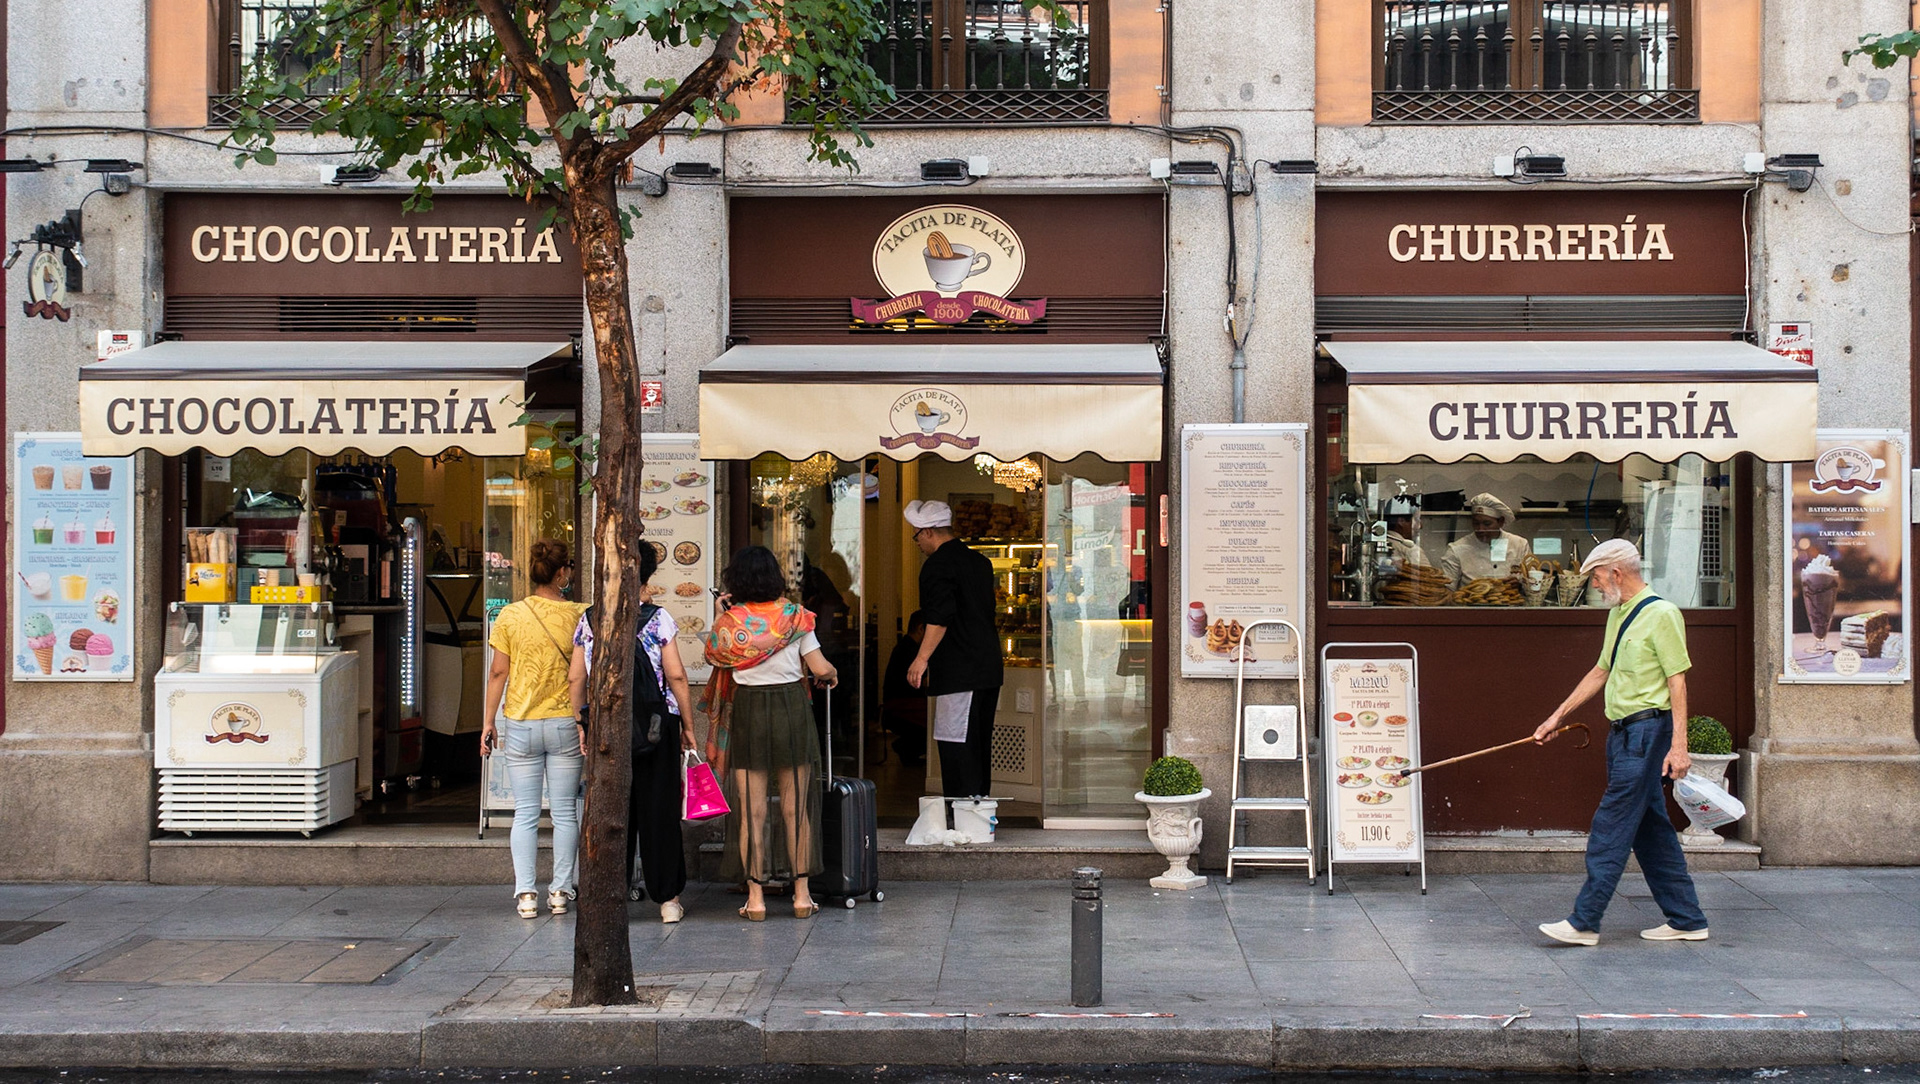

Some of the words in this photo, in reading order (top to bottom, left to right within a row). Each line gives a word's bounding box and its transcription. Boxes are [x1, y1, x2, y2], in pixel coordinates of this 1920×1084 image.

[191, 217, 562, 264] CHOCOLATERÍA
[880, 214, 938, 254] TACITA
[942, 212, 967, 226] DE
[969, 217, 1017, 259] PLATA
[1388, 215, 1674, 263] CHURRERÍA
[875, 293, 924, 320] CHURRERÍA
[936, 301, 960, 309] desde
[973, 293, 1031, 321] CHOCOLATERÍA
[933, 308, 965, 319] 1900
[892, 392, 923, 414] TACITA
[925, 391, 938, 399] DE
[938, 393, 964, 416] PLATA
[107, 388, 496, 434] CHOCOLATERÍA
[1429, 391, 1738, 441] CHURRERÍA
[1220, 442, 1266, 451] CHURRERÍA
[1218, 460, 1267, 470] REPOSTERÍA
[1821, 451, 1842, 467] TACITA
[1852, 452, 1870, 468] PLATA
[1218, 480, 1269, 488] CHOCOLATES
[1230, 500, 1256, 509] CAFÉS
[1219, 520, 1267, 528] INFUSIONES
[643, 528, 675, 536] CIONES
[1228, 538, 1259, 546] DULCES
[1226, 577, 1260, 585] BEBIDAS
[1349, 675, 1390, 688] MENÚ
[1356, 700, 1373, 709] PLATO
[213, 706, 234, 720] TACITA
[243, 705, 260, 722] PLATA
[1358, 745, 1374, 754] PLATO
[1361, 826, 1383, 843] 11,90
[1384, 825, 1392, 841] €
